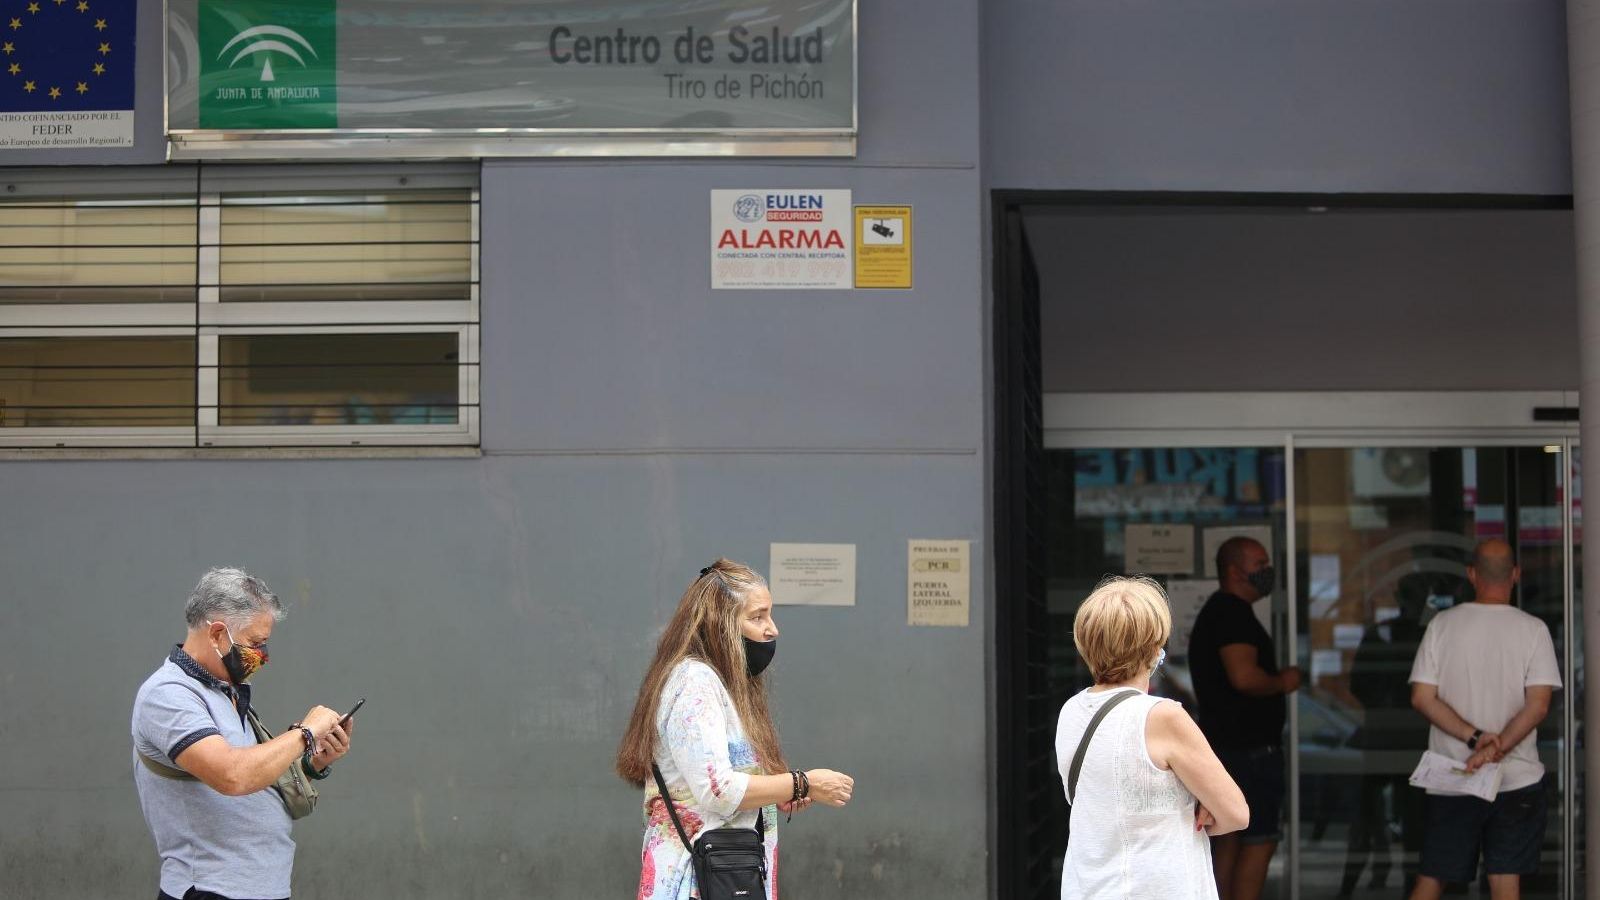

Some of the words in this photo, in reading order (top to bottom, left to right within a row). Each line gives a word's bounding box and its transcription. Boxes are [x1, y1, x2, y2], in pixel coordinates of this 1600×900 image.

[549, 26, 661, 64] Centro
[674, 26, 714, 64] de
[728, 25, 823, 64] Salud
[664, 73, 705, 99] Tiro
[714, 74, 740, 99] de
[751, 73, 823, 99] Pichón
[216, 88, 246, 99] JUNTA
[251, 88, 263, 98] DE
[22, 113, 90, 121] COFINANCIADO
[110, 112, 120, 120] EL
[32, 125, 72, 135] FEDER
[10, 138, 40, 146] Europeo
[41, 137, 50, 145] de
[766, 194, 823, 209] EULEN
[767, 212, 822, 220] SEGURIDAD
[718, 229, 845, 249] ALARMA
[928, 561, 949, 569] PCR
[913, 599, 962, 607] IZQUIERDA
